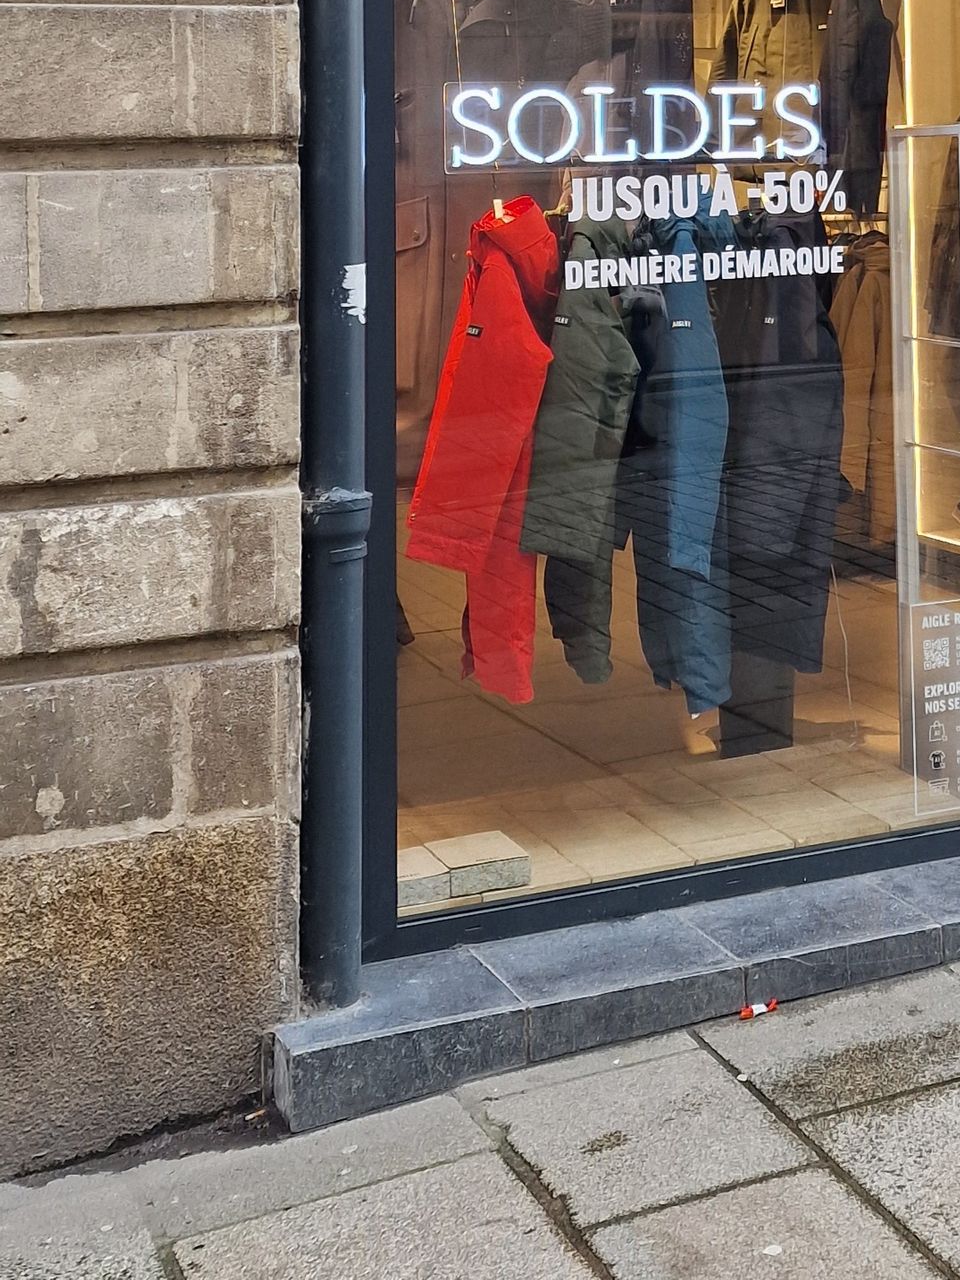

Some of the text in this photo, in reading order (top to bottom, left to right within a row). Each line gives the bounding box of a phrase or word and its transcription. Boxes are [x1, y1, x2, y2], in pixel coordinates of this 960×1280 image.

[450, 83, 822, 168] SOLDES
[568, 164, 847, 223] JUSQU'À -50%
[564, 244, 845, 291] DERNIÈRE DÉMARQUE
[921, 613, 951, 630] AIGLE
[924, 698, 947, 715] NOS
